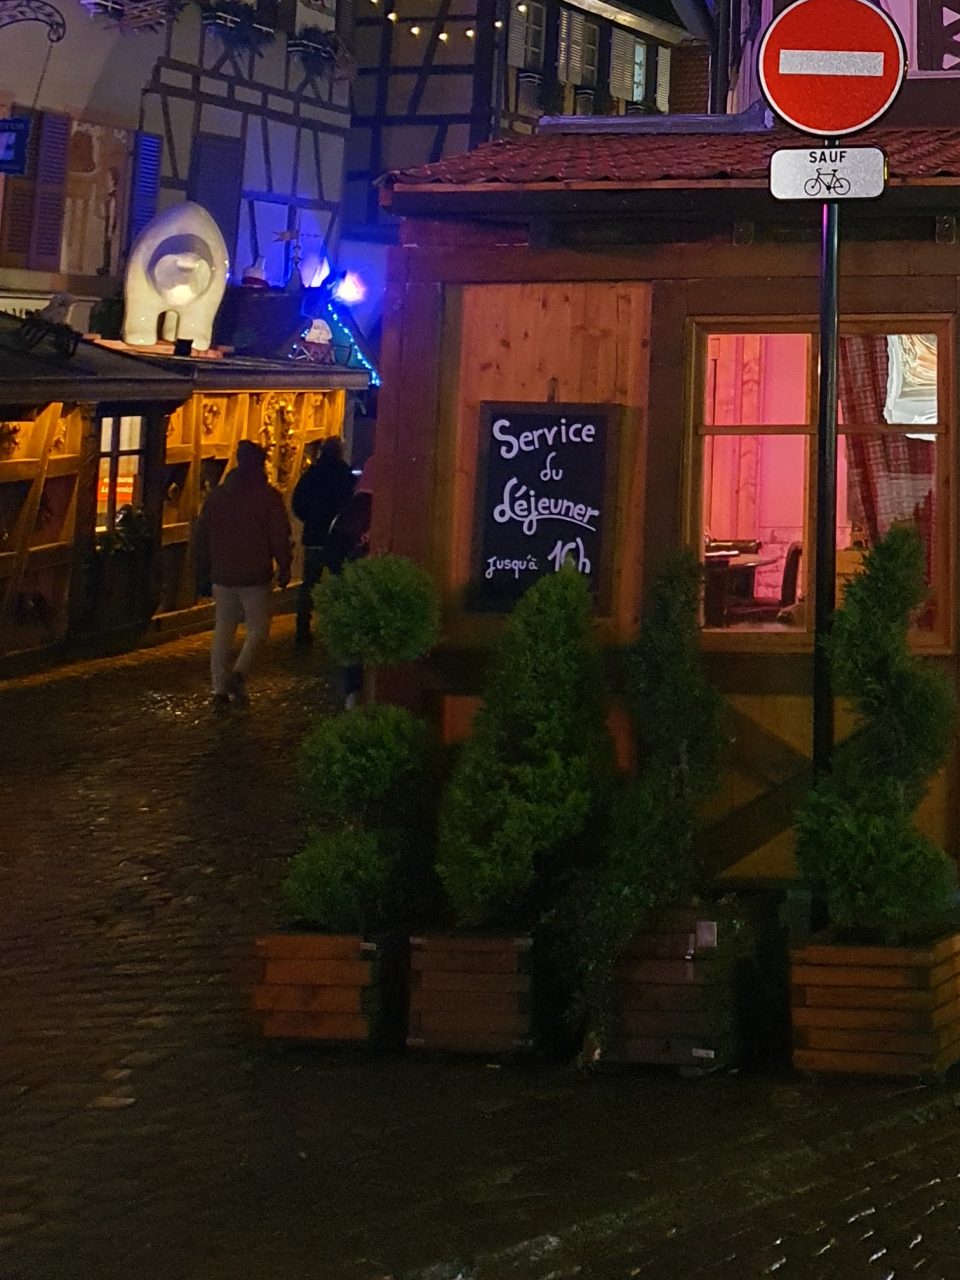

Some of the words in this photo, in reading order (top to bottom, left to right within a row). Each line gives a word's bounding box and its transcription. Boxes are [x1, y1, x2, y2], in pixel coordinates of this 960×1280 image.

[809, 151, 847, 163] SAUF
[493, 419, 595, 459] Service
[540, 451, 563, 481] du
